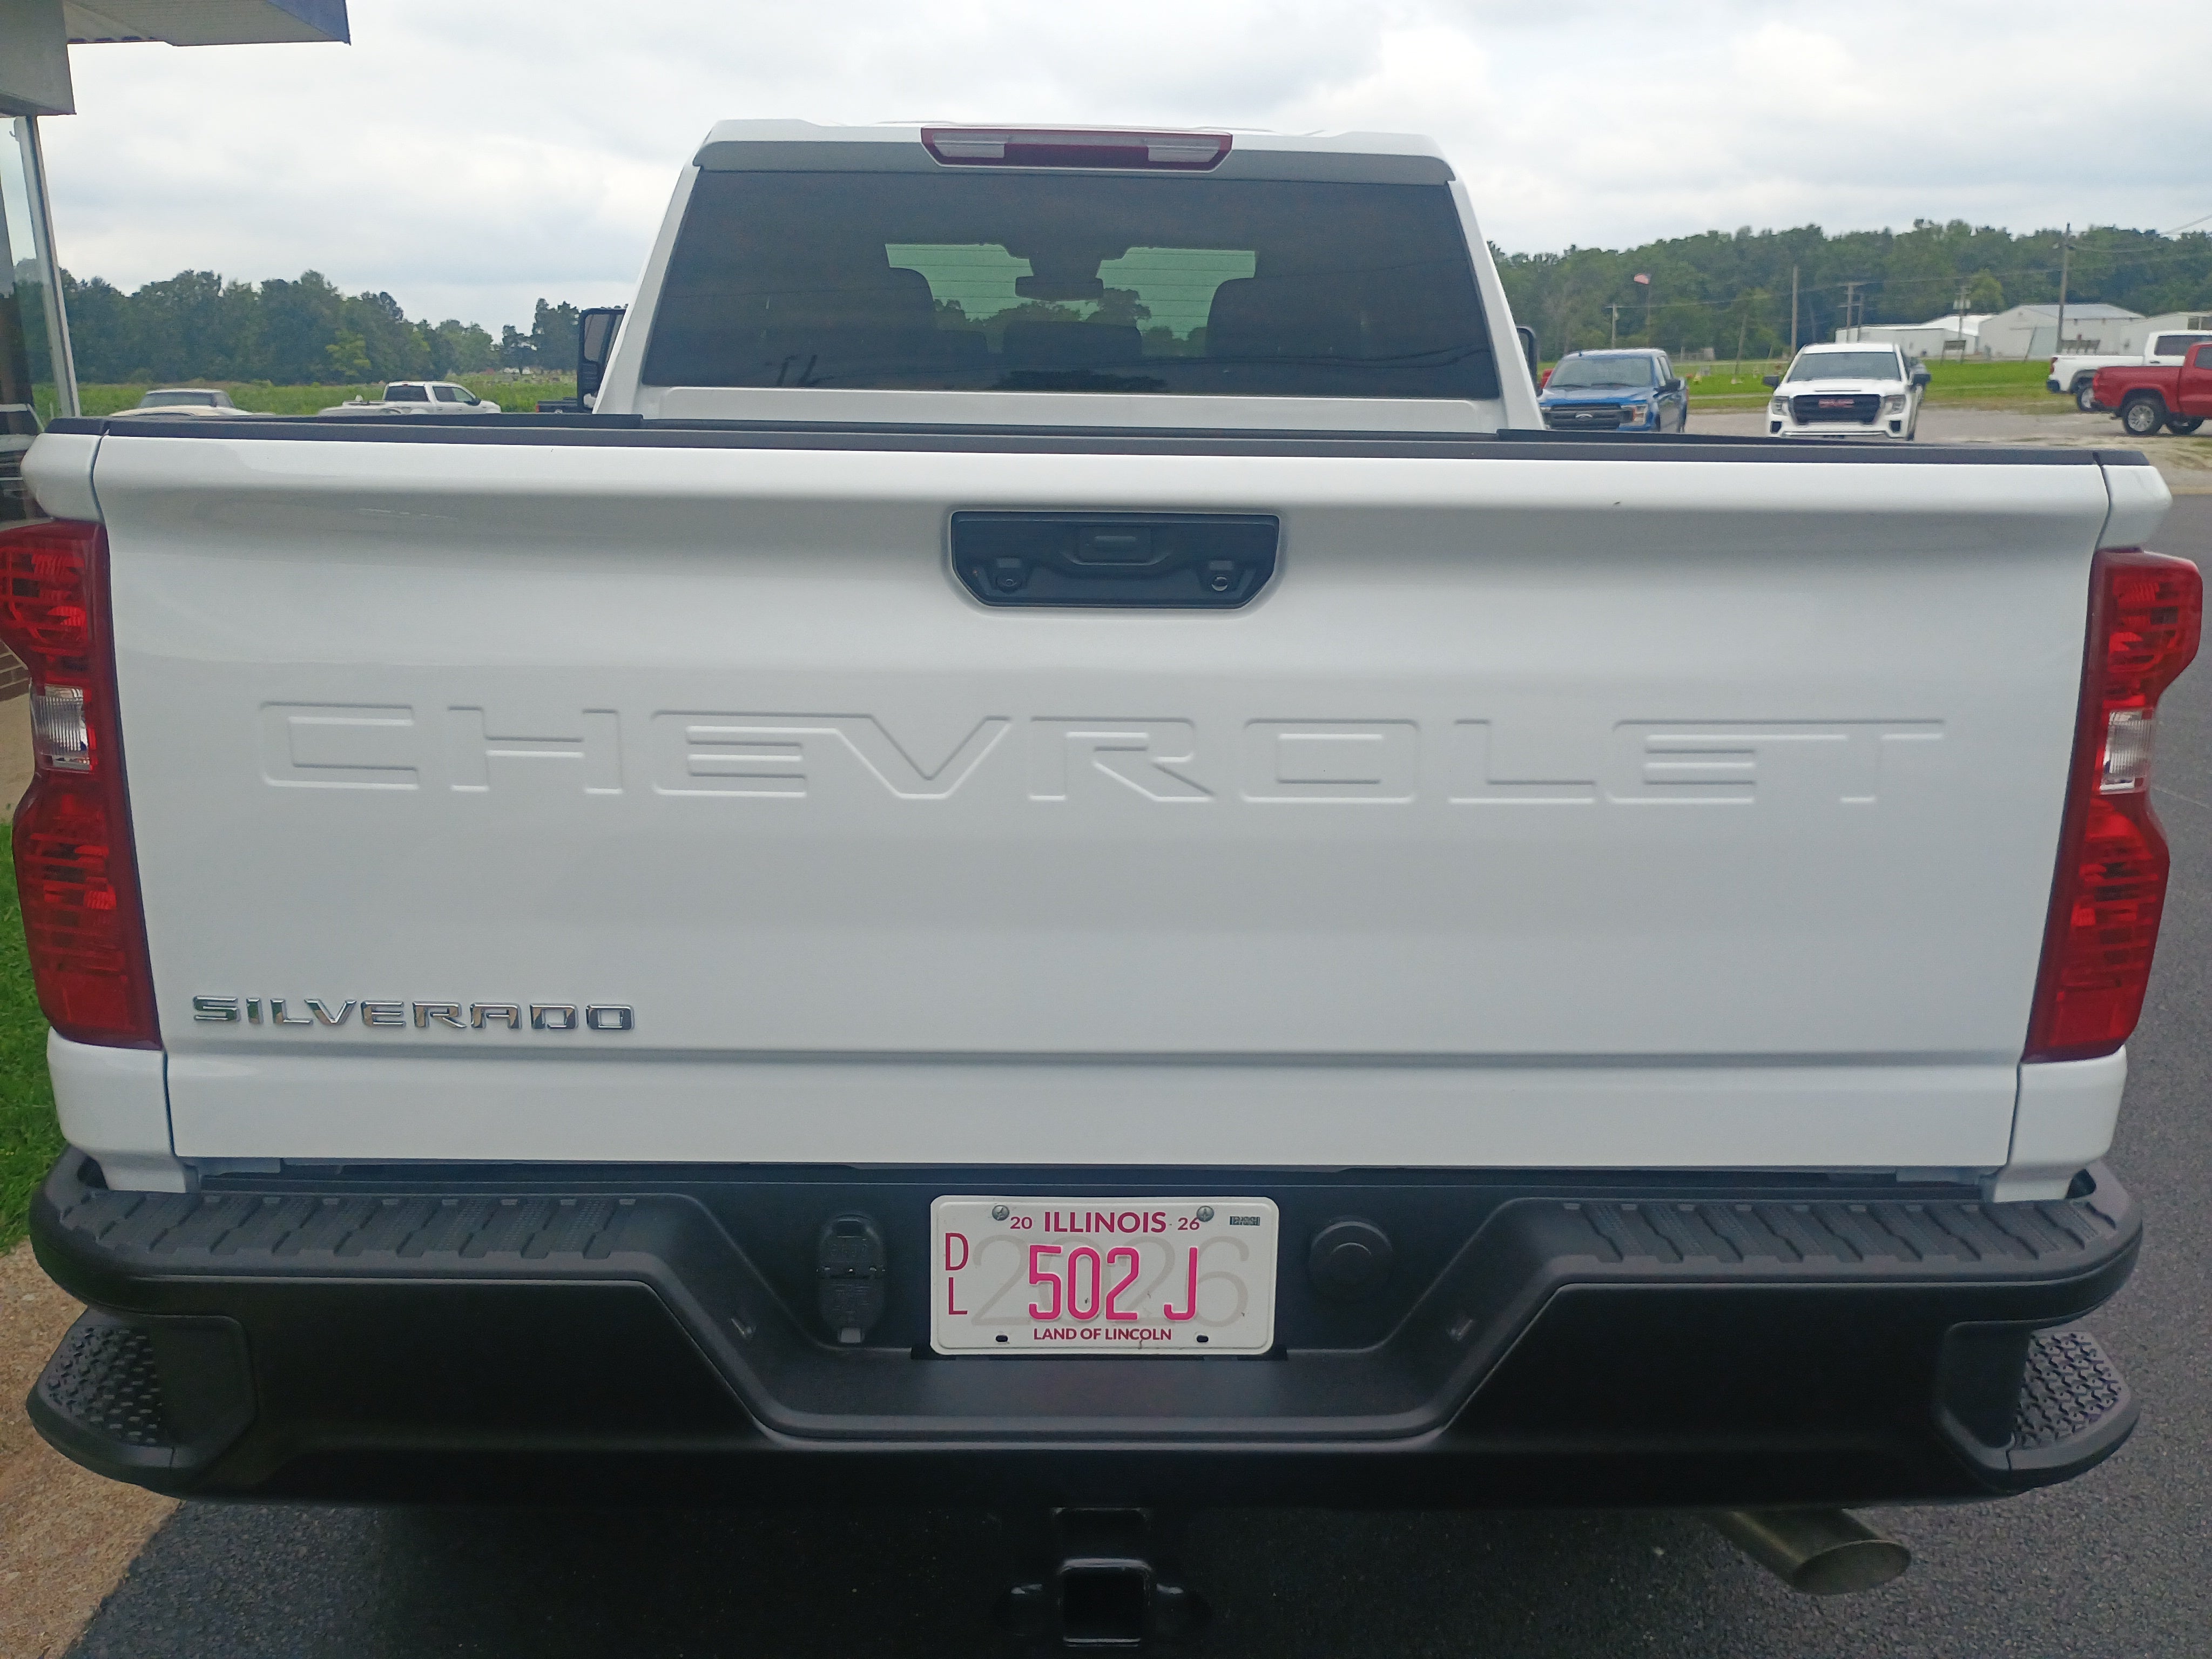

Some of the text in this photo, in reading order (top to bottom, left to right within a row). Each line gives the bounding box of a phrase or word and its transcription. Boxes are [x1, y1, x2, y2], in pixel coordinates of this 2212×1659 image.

[259, 701, 1945, 807] CHEVROLET
[192, 995, 636, 1031] SILVERADO
[1010, 1211, 1200, 1233] 20 ILLINOIS 26
[1028, 1244, 1198, 1321] 502 J
[1033, 1328, 1172, 1340] LAND OF LINCOLN
